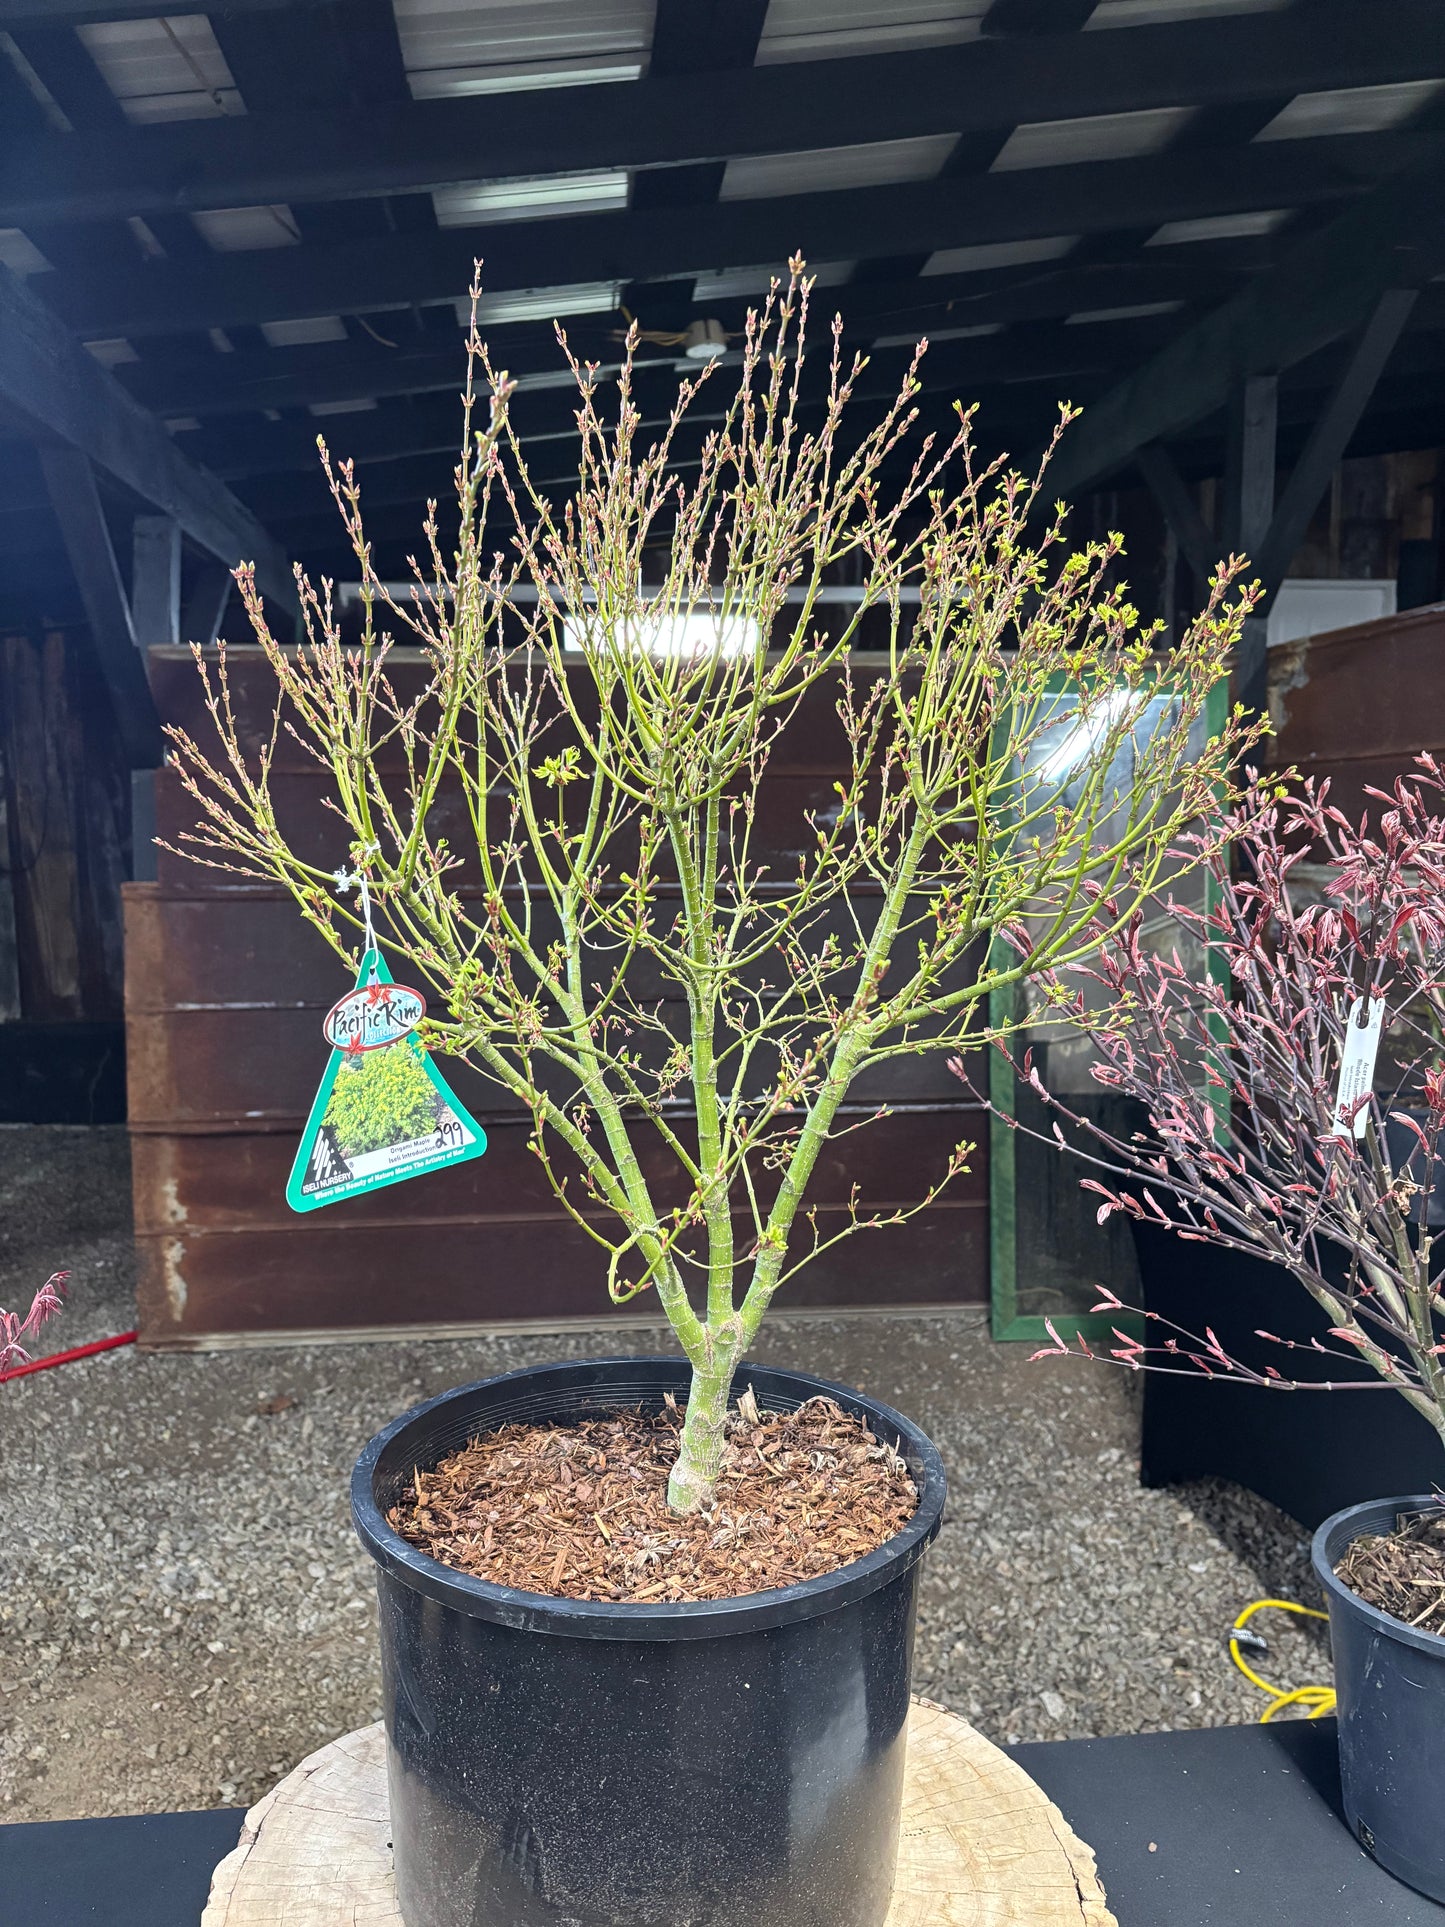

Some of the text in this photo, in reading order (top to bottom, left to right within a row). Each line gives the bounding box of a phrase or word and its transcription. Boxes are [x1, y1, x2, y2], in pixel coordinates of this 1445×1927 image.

[333, 999, 418, 1044] Pacific Rim
[390, 1138, 431, 1154] Origami Maple
[433, 1121, 464, 1149] 299
[302, 1171, 352, 1194] ISELI NURSERY
